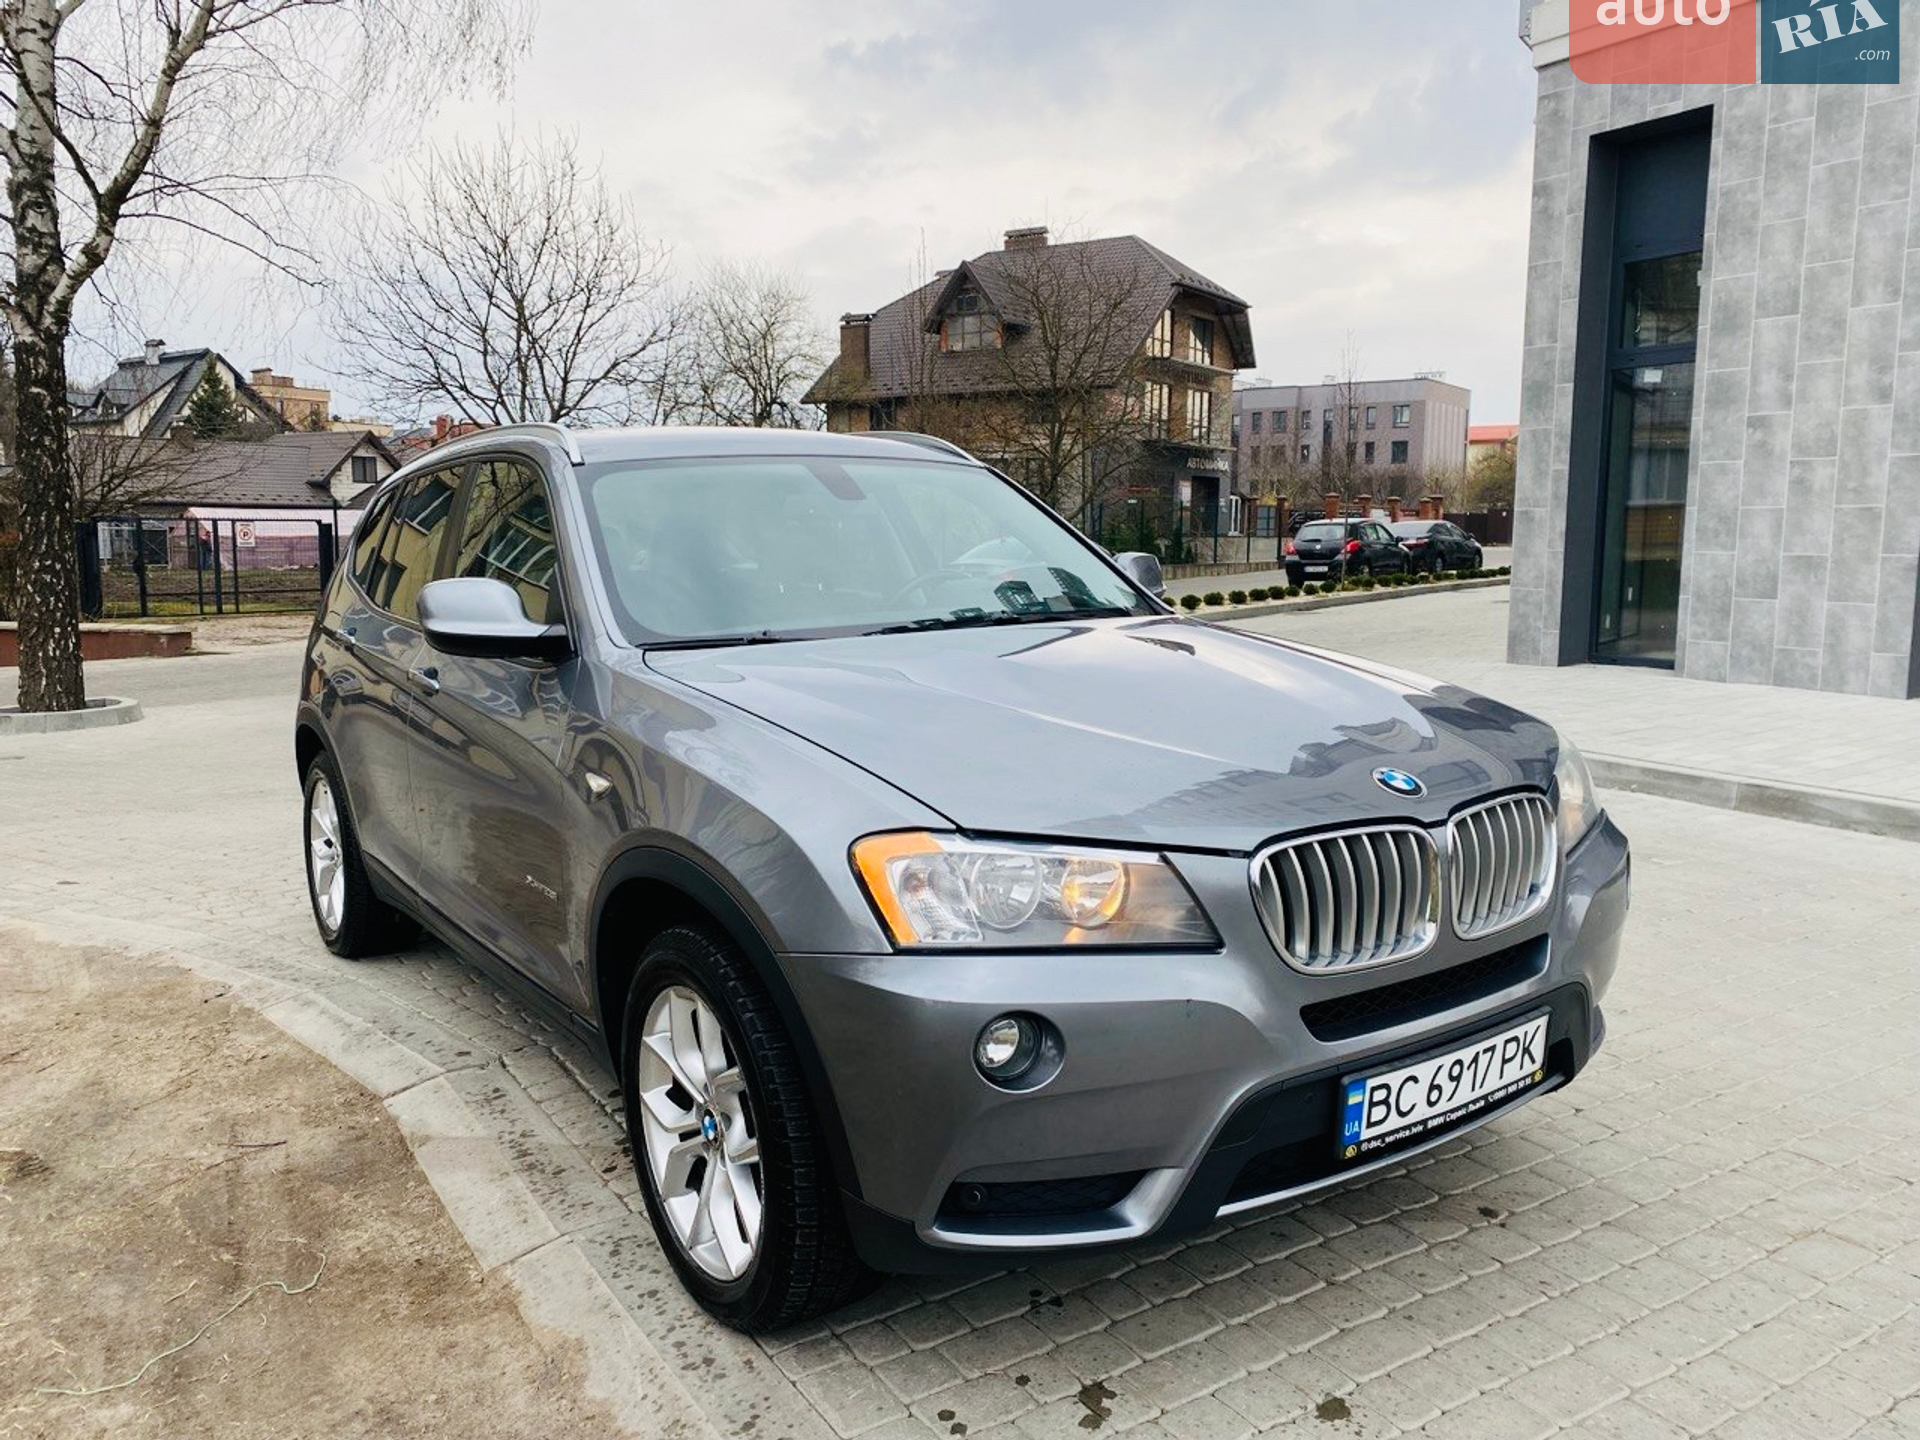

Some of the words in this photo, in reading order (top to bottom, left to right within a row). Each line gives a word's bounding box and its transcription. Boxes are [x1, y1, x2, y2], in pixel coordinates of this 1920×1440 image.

[1365, 1075, 1420, 1130] BC
[1426, 1044, 1497, 1108] 6917
[1499, 1024, 1541, 1081] PK
[1344, 1120, 1360, 1136] UA
